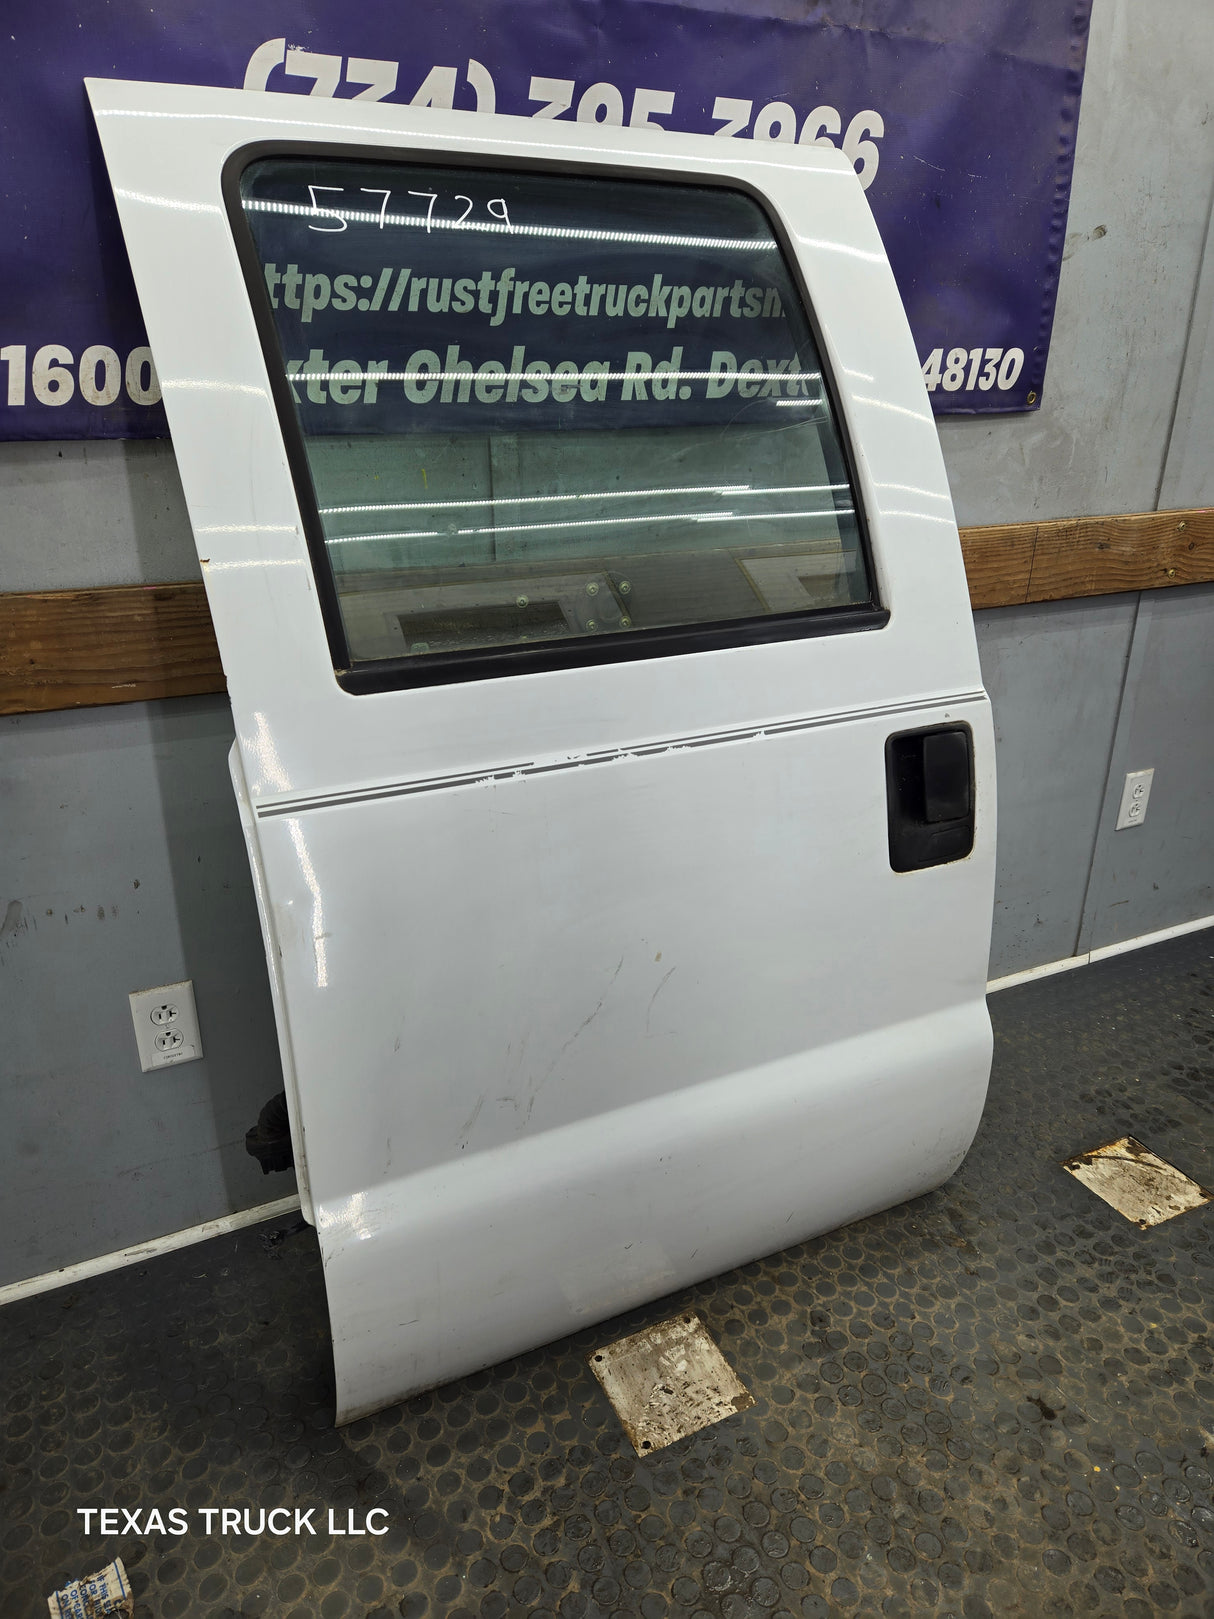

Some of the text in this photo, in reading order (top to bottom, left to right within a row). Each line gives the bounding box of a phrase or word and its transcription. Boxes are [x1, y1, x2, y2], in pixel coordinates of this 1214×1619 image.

[307, 185, 514, 234] 57729
[0, 344, 162, 407] 1600
[403, 345, 610, 404] Chelsea
[620, 346, 692, 401] Rd.
[921, 347, 1025, 392] 48130
